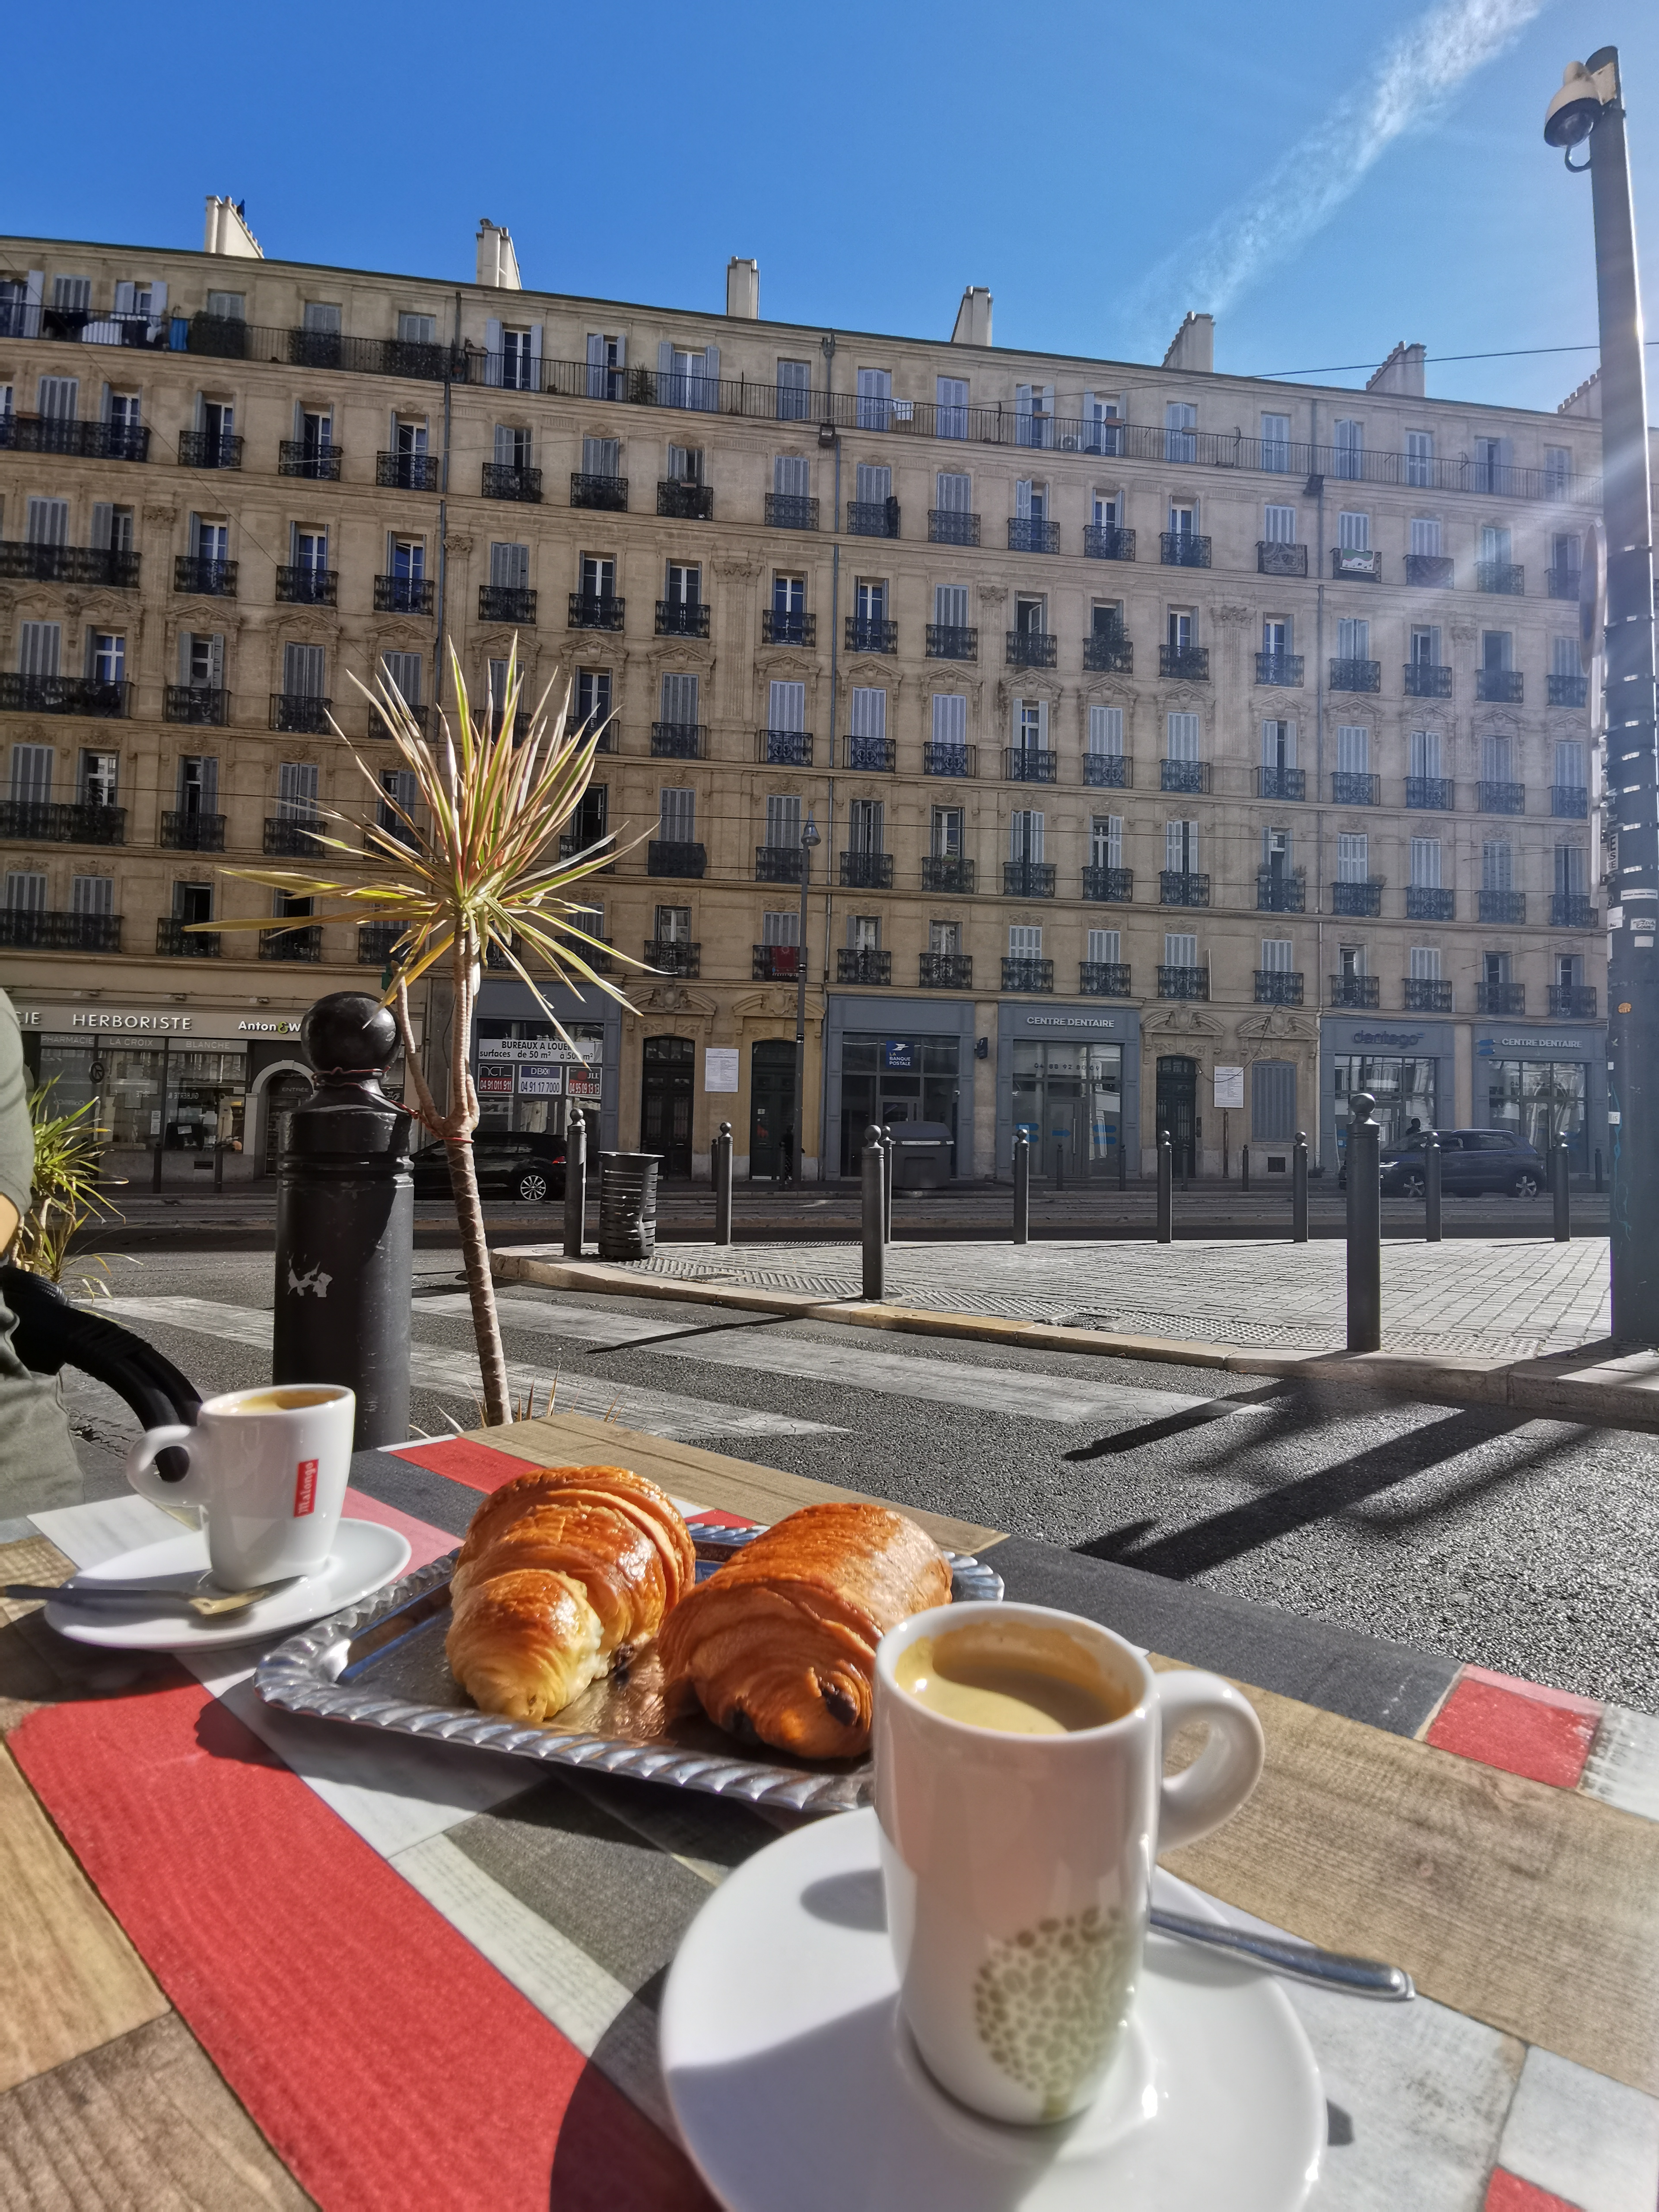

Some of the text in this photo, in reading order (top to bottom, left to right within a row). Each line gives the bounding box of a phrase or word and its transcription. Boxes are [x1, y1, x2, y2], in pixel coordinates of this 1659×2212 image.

[73, 1014, 191, 1030] HERBORISTE
[1027, 1017, 1115, 1027] CENTRE DENTAIRE
[41, 1035, 94, 1045] PHARMACIE
[124, 1038, 153, 1047] CROIX
[1354, 1030, 1419, 1049] dentego
[1502, 1038, 1583, 1048] CENTRE DENTAIRE
[186, 1041, 230, 1049] BLANCHE
[502, 1041, 538, 1050] BUREAUX
[480, 1049, 511, 1058] surfaces
[517, 1050, 527, 1058] de
[480, 1080, 487, 1090] 04
[487, 1080, 493, 1090] 91
[521, 1081, 560, 1093] 04 91 17 7000
[298, 1462, 316, 1514] Malongo
